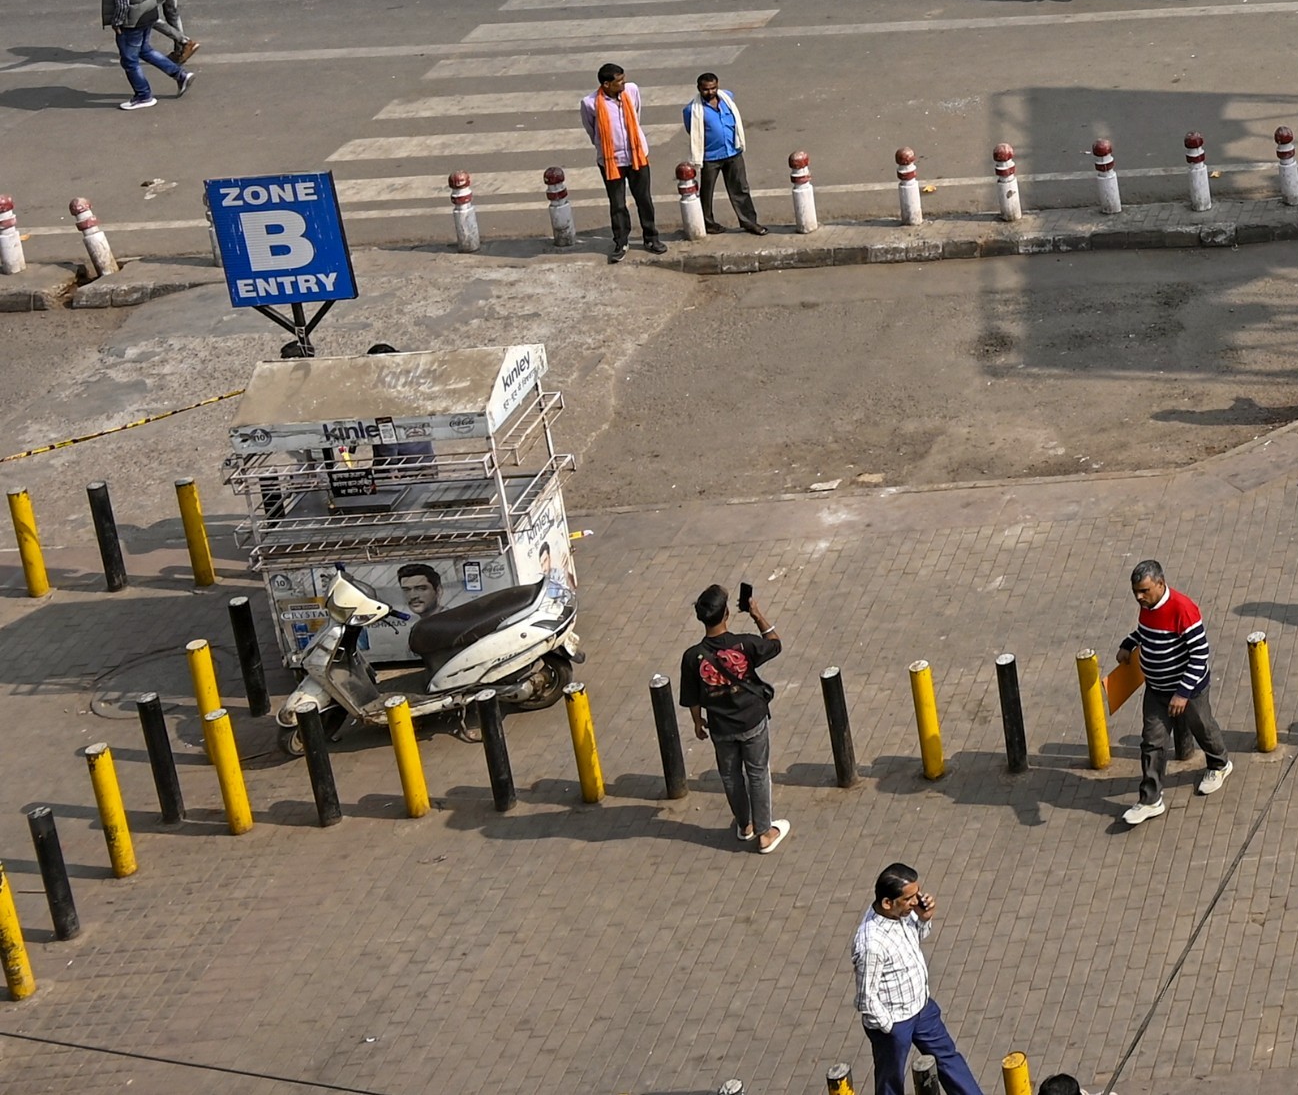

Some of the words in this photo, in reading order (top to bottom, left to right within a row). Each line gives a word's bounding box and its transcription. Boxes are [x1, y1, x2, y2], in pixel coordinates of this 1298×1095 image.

[219, 182, 318, 207] ZONE
[239, 210, 314, 272] B
[236, 272, 337, 298] ENTRY
[502, 351, 531, 392] kinley
[322, 421, 381, 441] kinle
